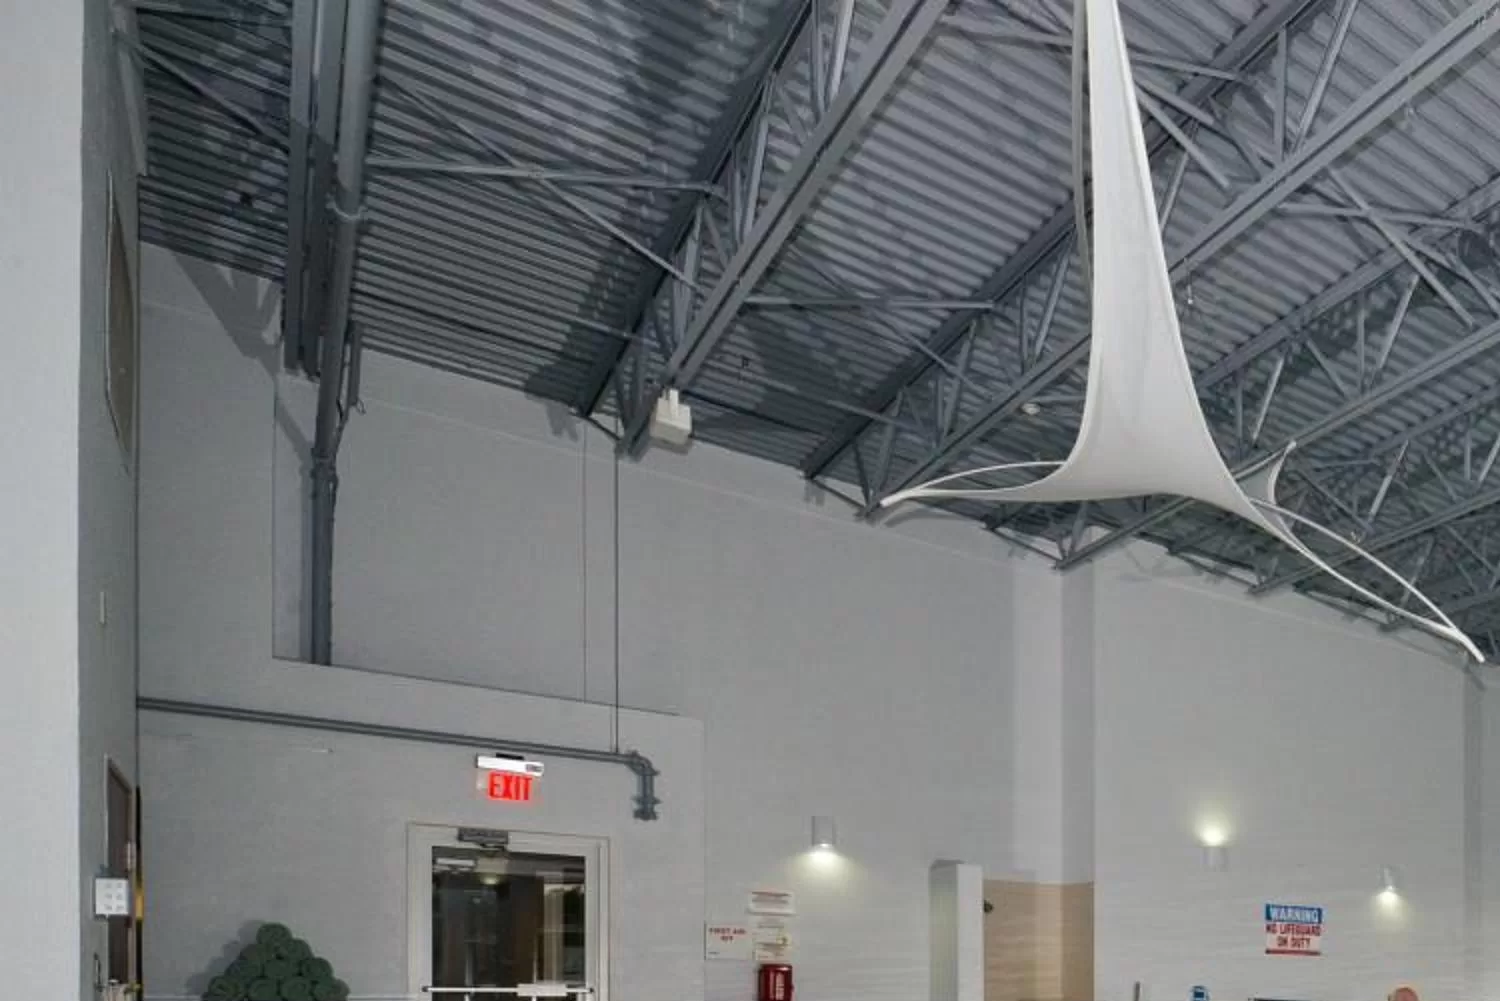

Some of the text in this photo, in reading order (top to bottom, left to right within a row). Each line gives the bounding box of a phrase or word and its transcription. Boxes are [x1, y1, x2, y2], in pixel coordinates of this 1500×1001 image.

[488, 771, 532, 801] EXIT
[1271, 907, 1318, 923] WARNING
[1266, 923, 1321, 936] NO LIFEGUARD
[1277, 936, 1310, 949] ON DUTY
